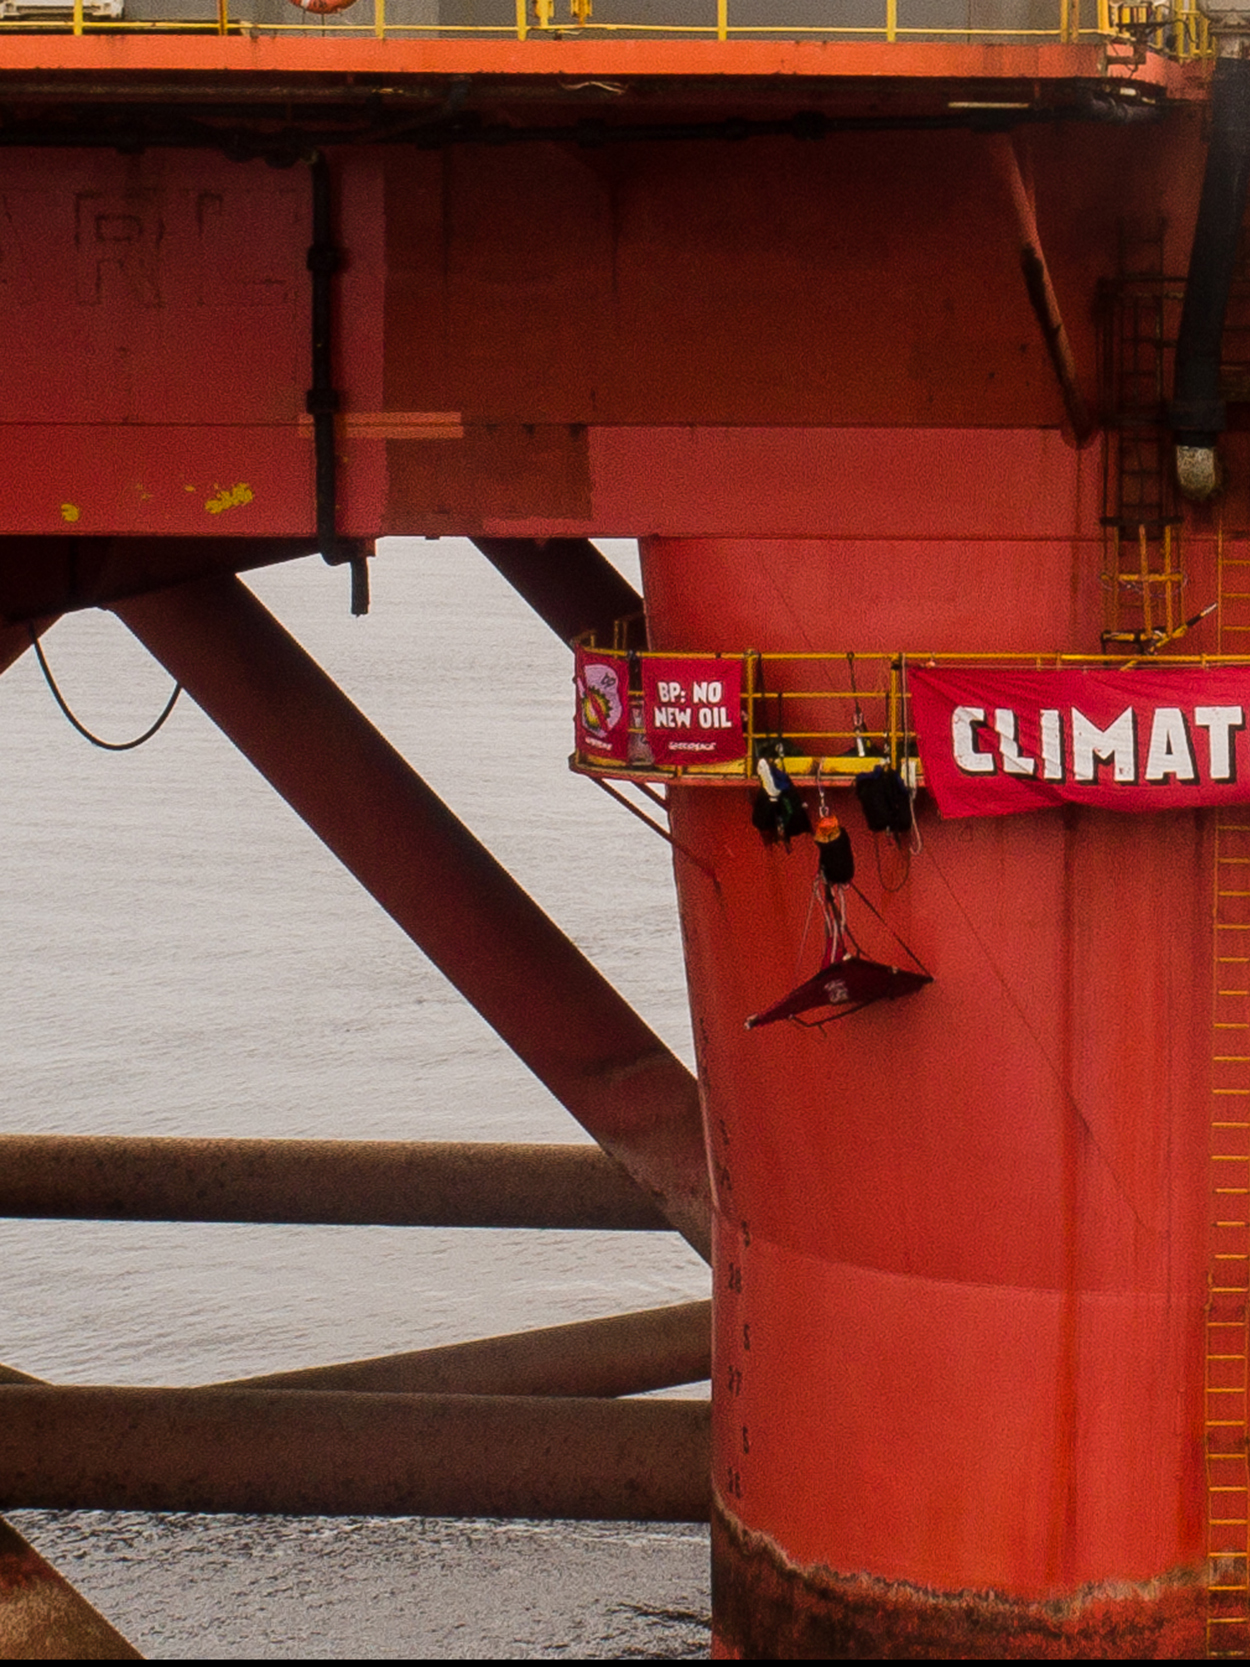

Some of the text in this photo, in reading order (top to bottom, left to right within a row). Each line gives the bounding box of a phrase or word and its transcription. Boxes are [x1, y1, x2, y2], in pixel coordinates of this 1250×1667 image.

[657, 681, 722, 704] BP: NO
[654, 706, 732, 729] NEW OIL
